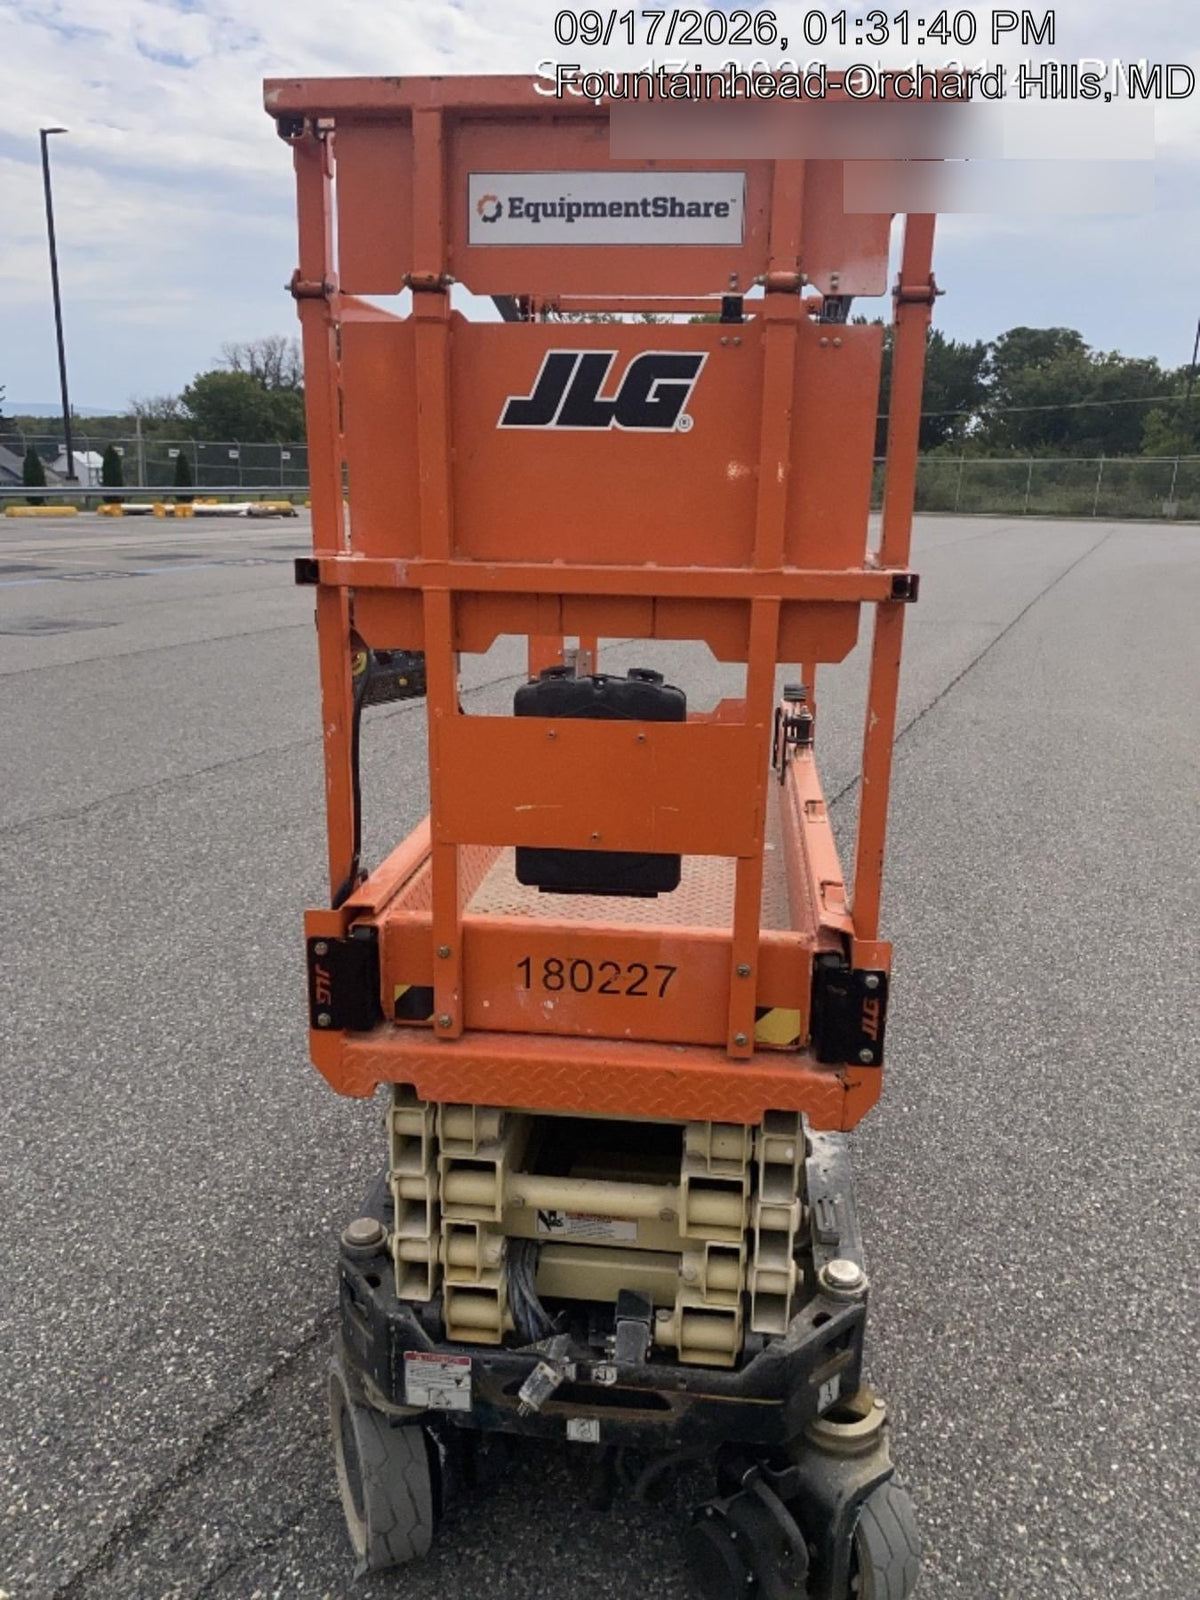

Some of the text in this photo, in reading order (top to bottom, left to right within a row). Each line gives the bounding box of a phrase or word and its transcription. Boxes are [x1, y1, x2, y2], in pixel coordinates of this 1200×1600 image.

[507, 195, 730, 223] EquipmentShare
[496, 348, 710, 432] JLG
[516, 956, 678, 998] 180227
[861, 996, 880, 1041] JLG
